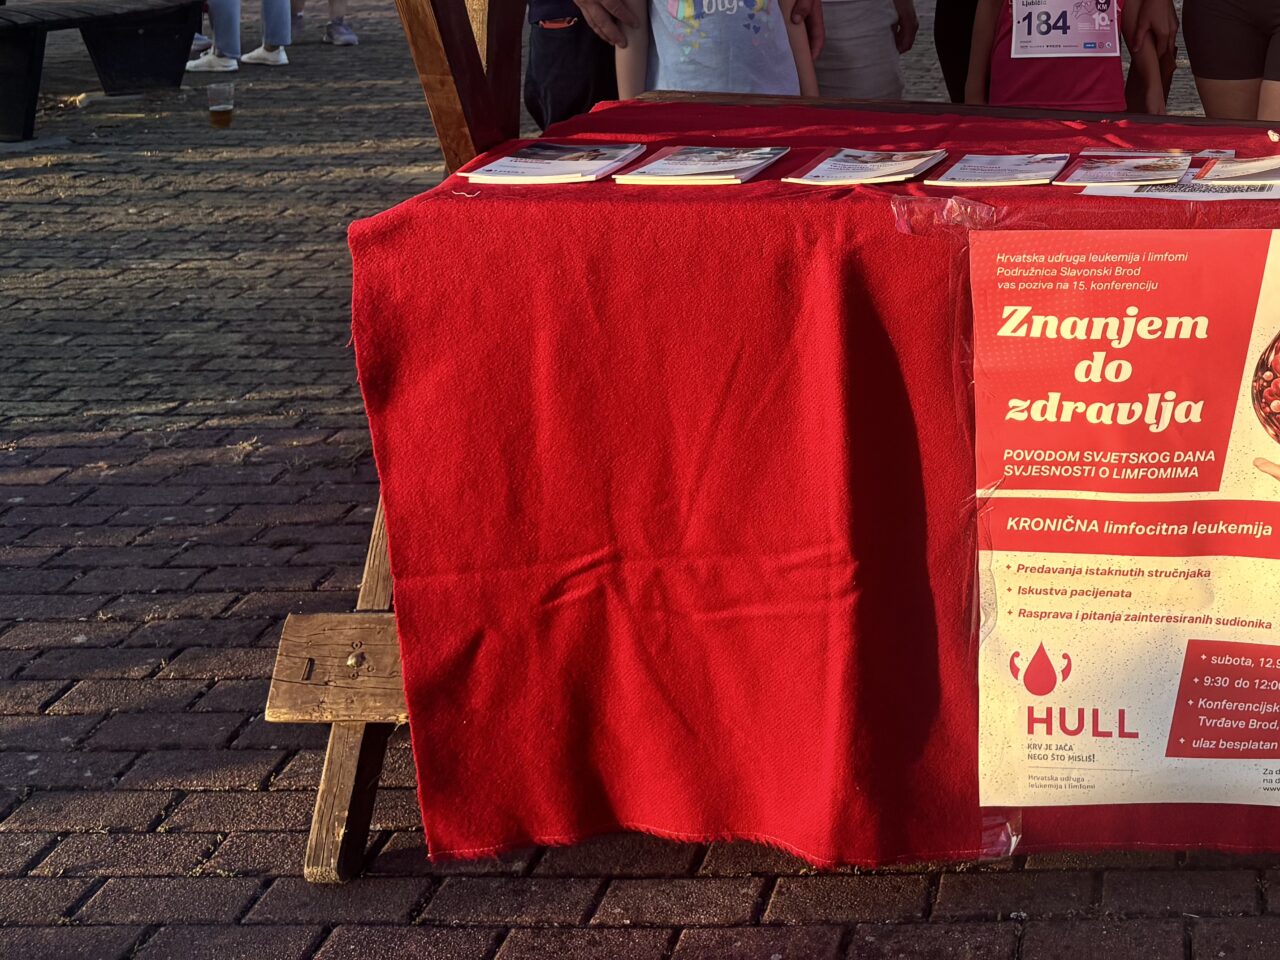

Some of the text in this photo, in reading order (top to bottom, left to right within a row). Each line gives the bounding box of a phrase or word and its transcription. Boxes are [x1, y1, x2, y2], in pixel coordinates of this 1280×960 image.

[1021, 10, 1071, 36] 184
[996, 251, 1189, 265] Hrvatska udruga leukemija i limfomi
[996, 266, 1141, 277] Podružnica Slavonski Brod
[1018, 281, 1053, 291] poziva
[1073, 281, 1088, 290] 15.
[1090, 280, 1159, 292] konferenciju
[996, 305, 1209, 349] Znanjem
[1073, 351, 1133, 383] do
[1004, 390, 1205, 433] zdravlja
[1003, 449, 1216, 464] POVODOM SVJETSKOG DANA
[1003, 464, 1199, 480] SVJESNOSTI O LIMFOMIMA
[1006, 515, 1273, 539] KRONIČNA limfocitna leukemija
[1016, 563, 1211, 580] Predavanja istaknutih stručnjaka
[1017, 585, 1132, 599] Iskustva pacijenata
[1018, 608, 1273, 630] Rasprava i pitanja zainteresiranih sudionika
[1210, 654, 1255, 668] subota,
[1203, 676, 1230, 687] 9:30
[1234, 677, 1250, 688] do
[1027, 706, 1139, 739] HULL
[1198, 716, 1246, 728] Tvrđave
[1248, 718, 1279, 731] Brod,
[1027, 743, 1043, 751] KRV
[1055, 743, 1074, 752] JAČA
[1192, 738, 1278, 751] ulaz besplatan
[1027, 753, 1096, 763] NEGO ŠTO MISLIŠ!
[1028, 774, 1085, 784] Hrvatska udruga
[1262, 768, 1274, 776] Za
